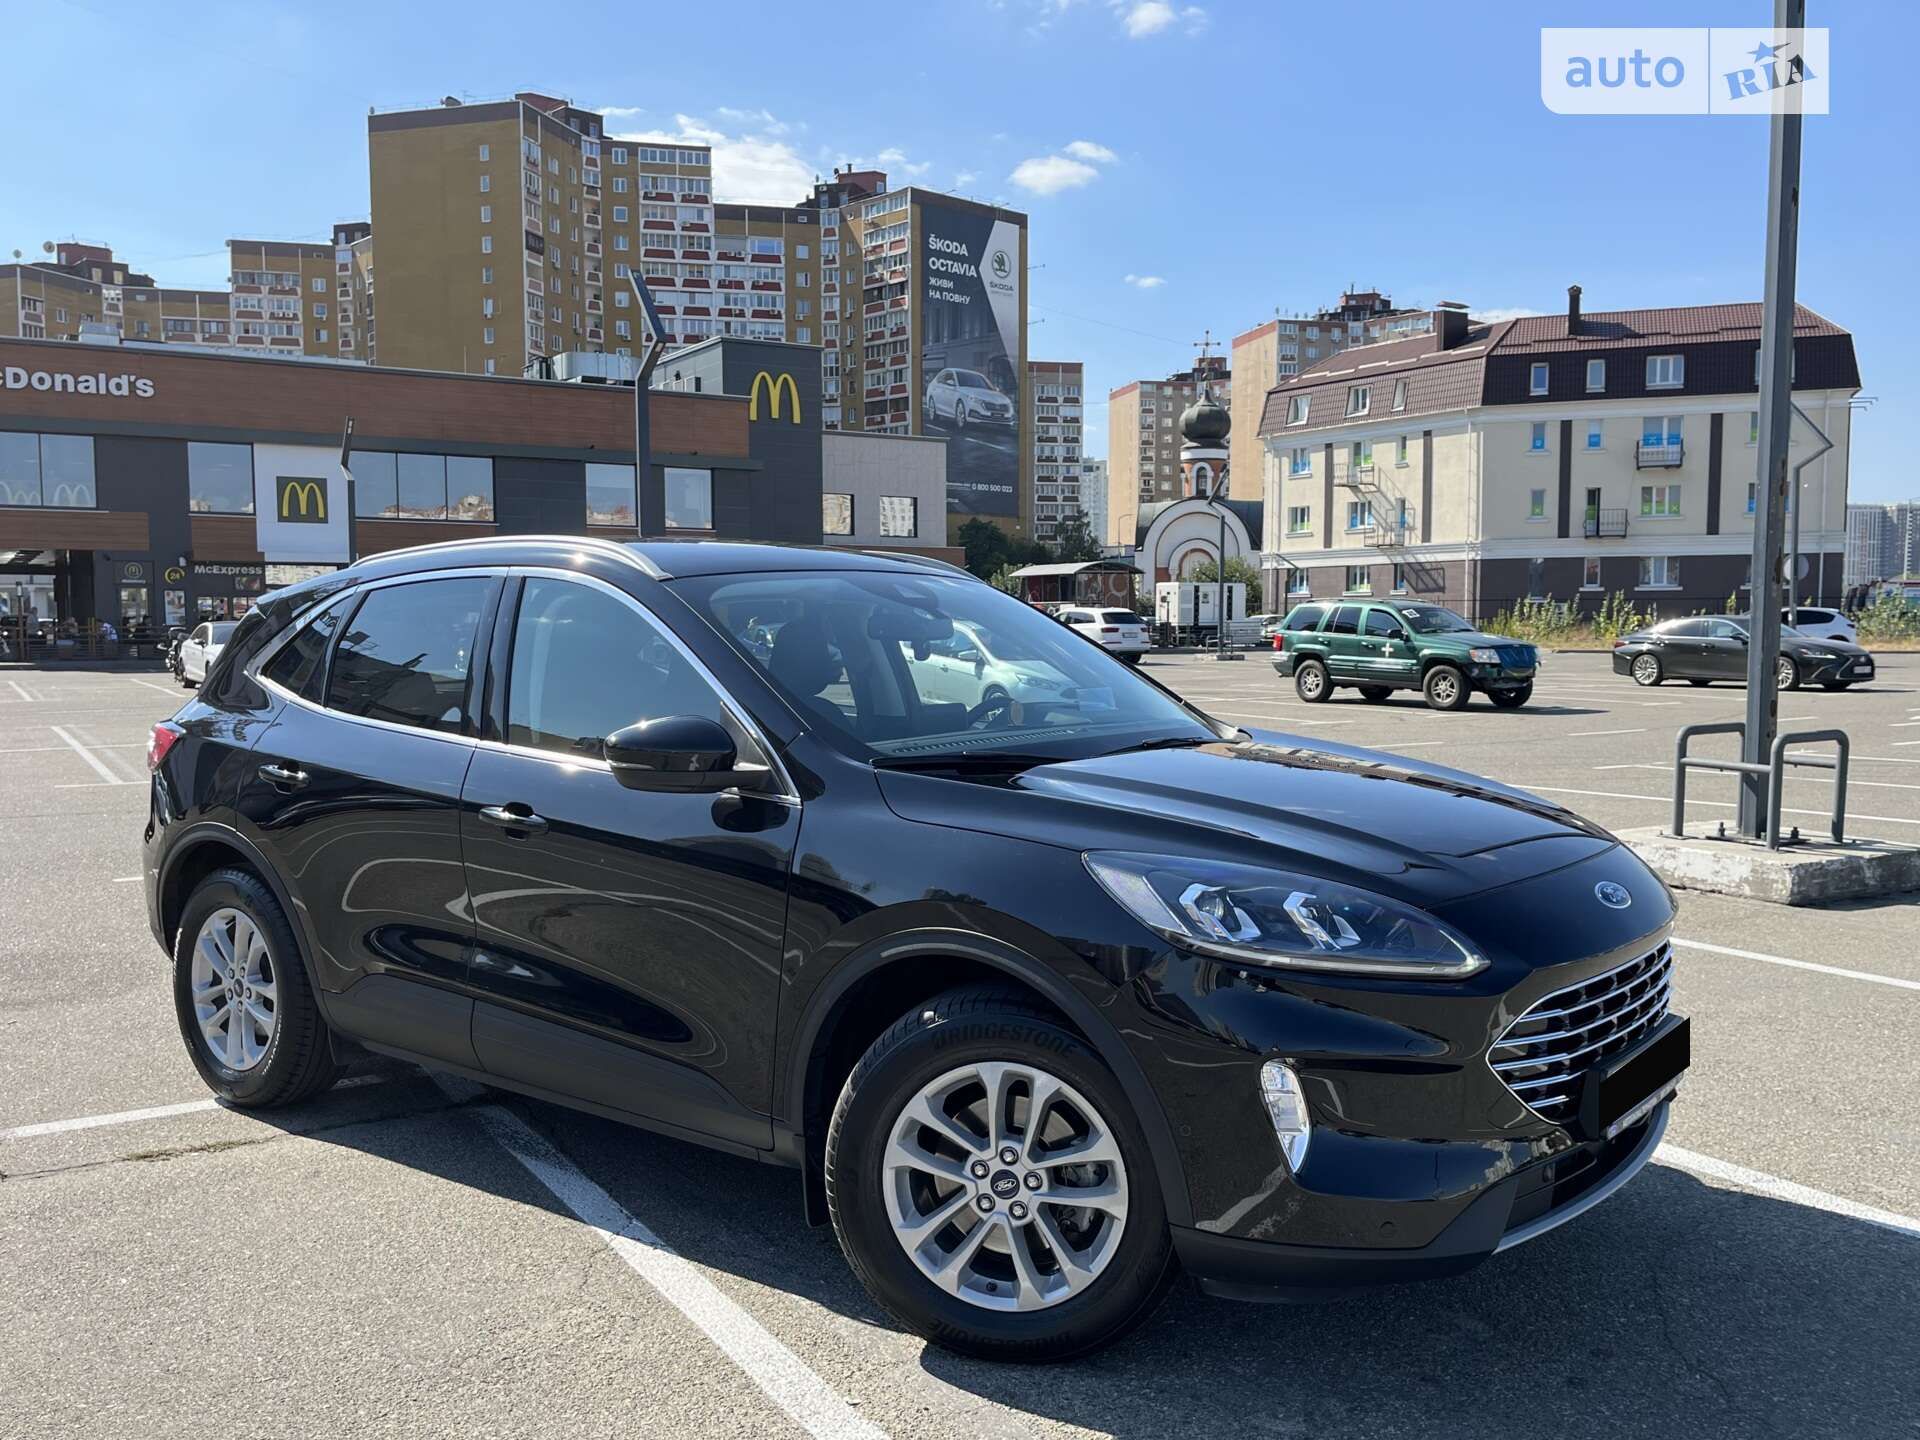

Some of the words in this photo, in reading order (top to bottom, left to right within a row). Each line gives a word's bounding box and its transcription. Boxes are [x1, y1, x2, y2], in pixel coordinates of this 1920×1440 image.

[928, 233, 968, 257] ŠKODA
[928, 257, 978, 278] OCTAVIA
[928, 276, 954, 289] ЖИВИ
[928, 289, 941, 300] НА
[942, 292, 971, 305] ПОВНУ
[0, 366, 155, 398] Donald's
[194, 565, 263, 575] McExpress
[932, 1023, 1078, 1056] BRIDGESTONE
